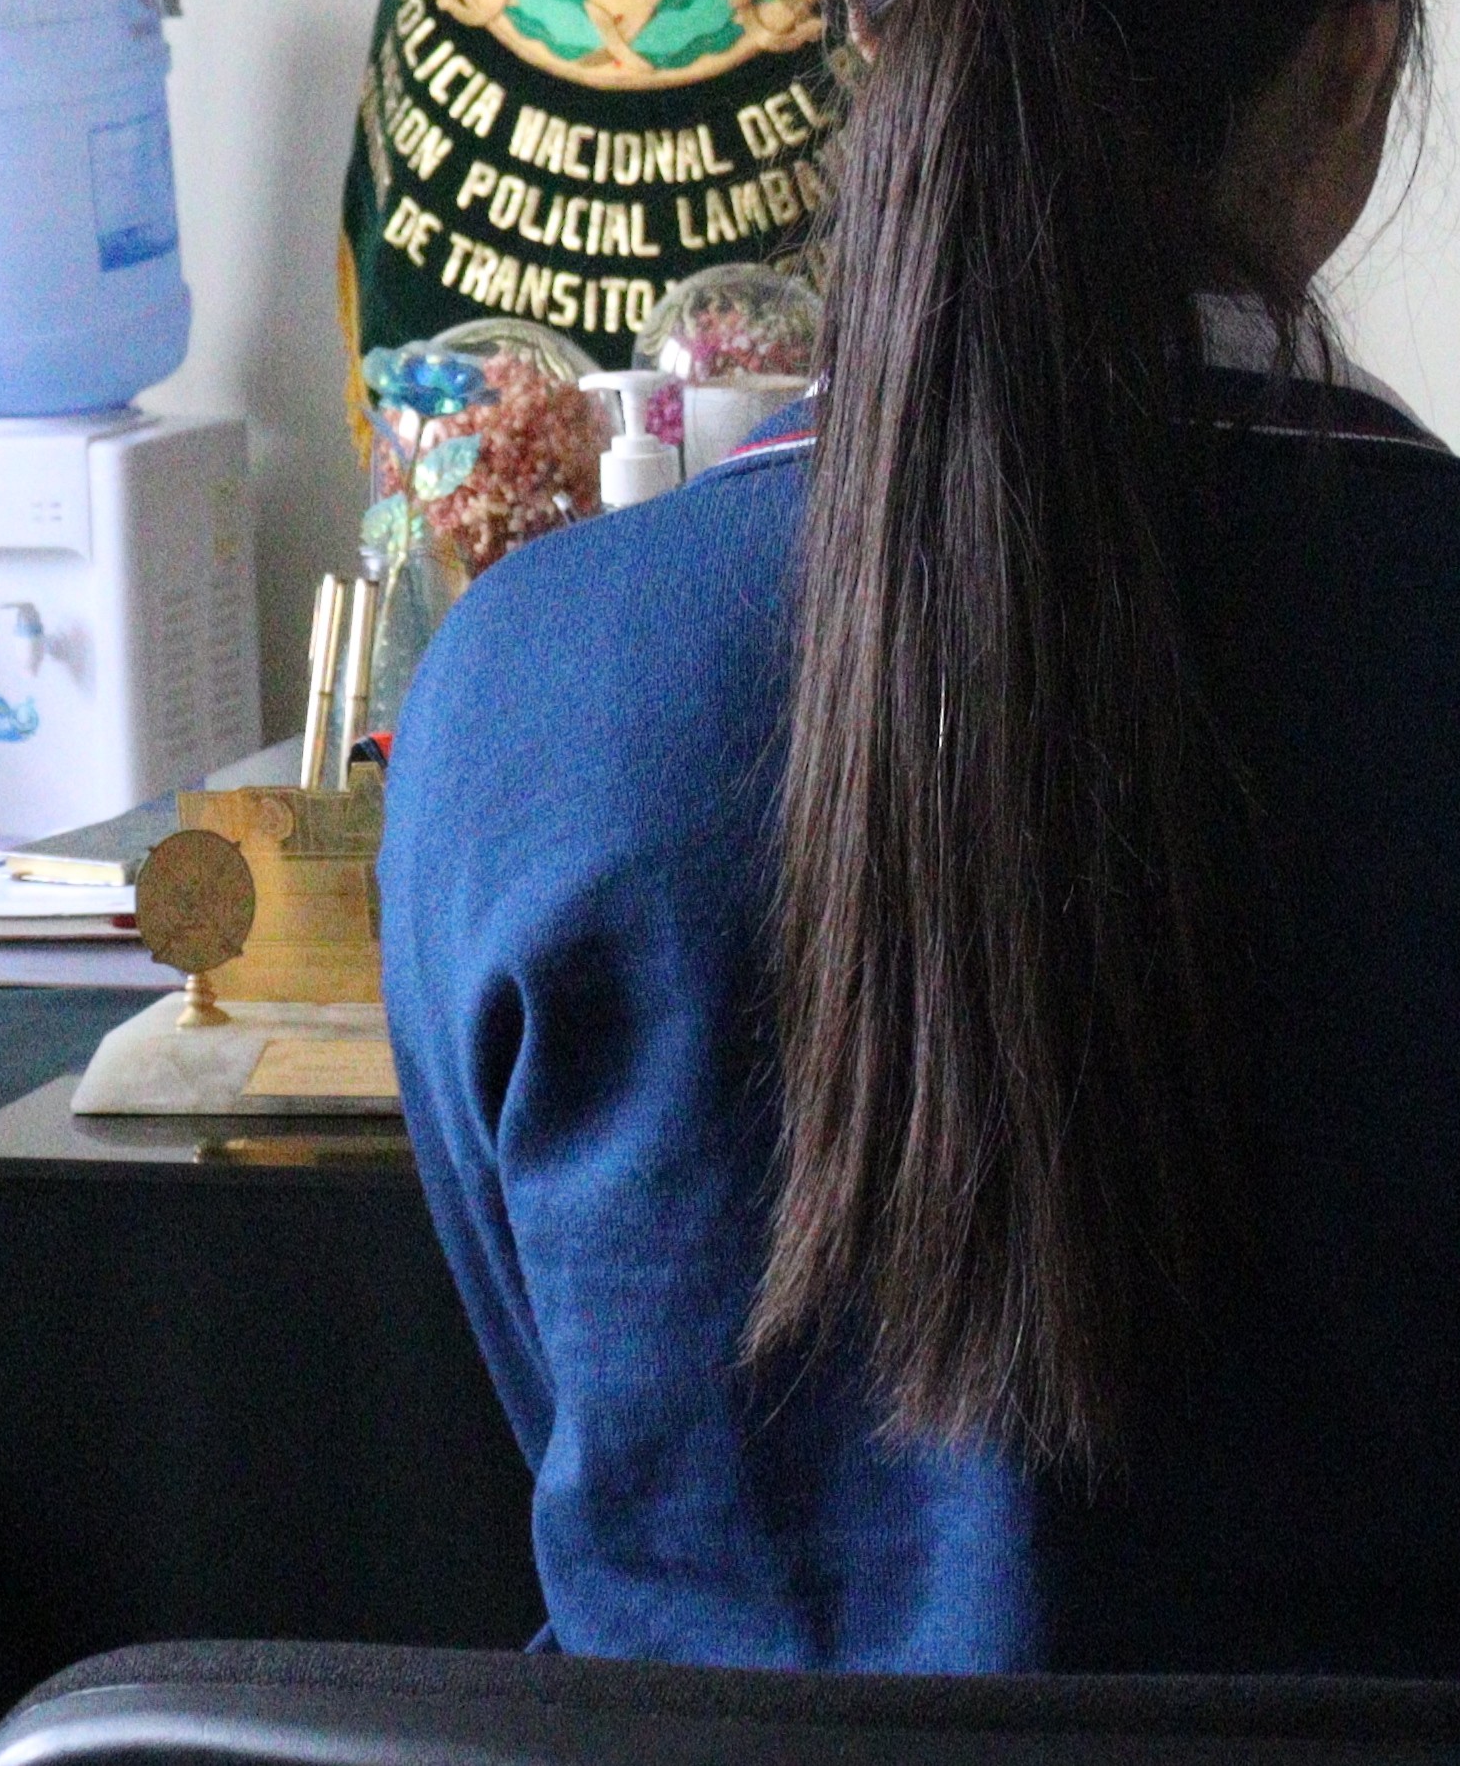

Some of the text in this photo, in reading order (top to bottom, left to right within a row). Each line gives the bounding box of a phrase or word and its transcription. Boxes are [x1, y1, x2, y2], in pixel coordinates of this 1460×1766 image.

[509, 105, 734, 186] NACIONAL
[737, 81, 830, 159] DEL
[456, 160, 661, 257] POLICIAL
[383, 196, 653, 334] DE TRANSITO
